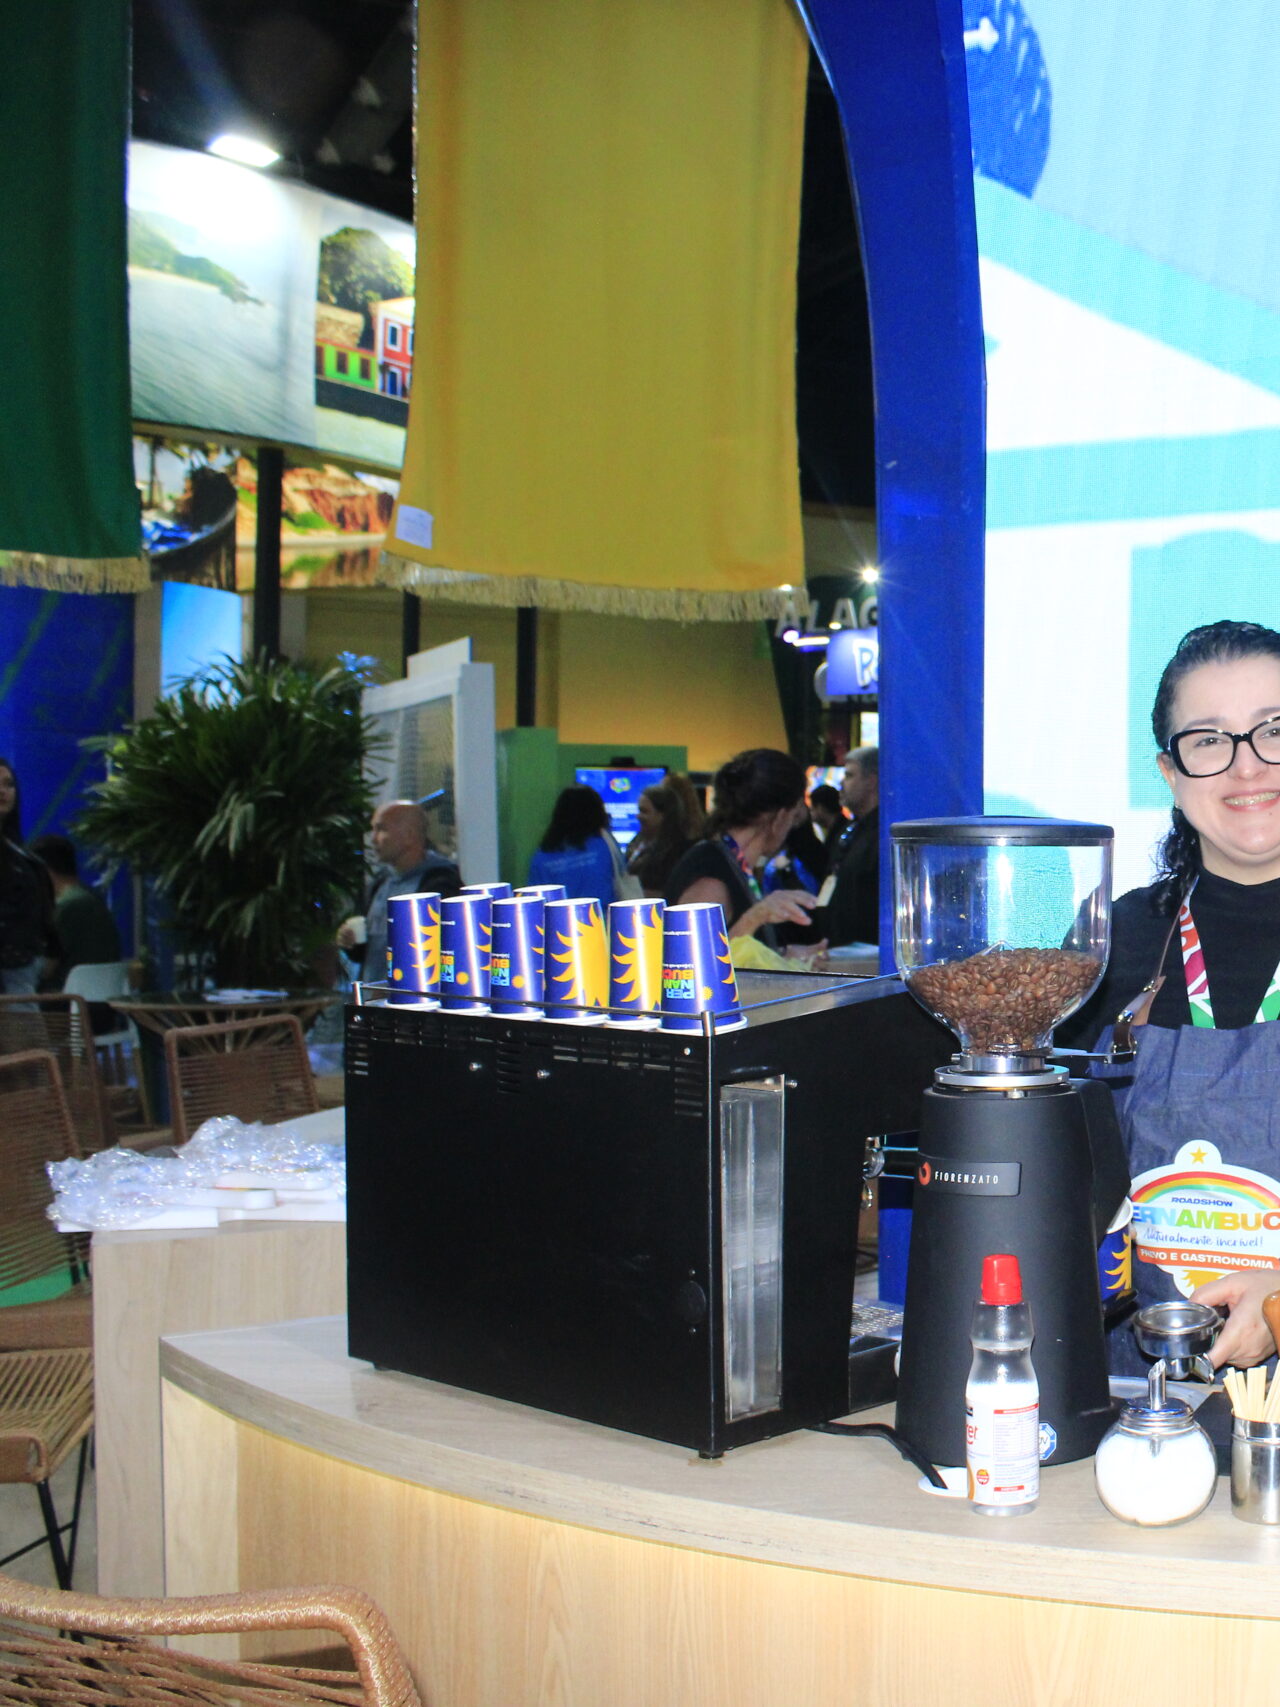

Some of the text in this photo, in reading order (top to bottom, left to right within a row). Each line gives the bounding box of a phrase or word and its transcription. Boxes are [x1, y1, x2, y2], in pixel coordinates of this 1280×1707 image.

[662, 969, 694, 979] BUC
[666, 988, 695, 999] PER
[934, 1171, 999, 1184] FIORENZATO
[1171, 1197, 1233, 1207] ROADSHOW
[1144, 1228, 1212, 1246] Naturalmente
[1170, 1252, 1177, 1261] E
[1180, 1253, 1274, 1269] GASTRONOMIA
